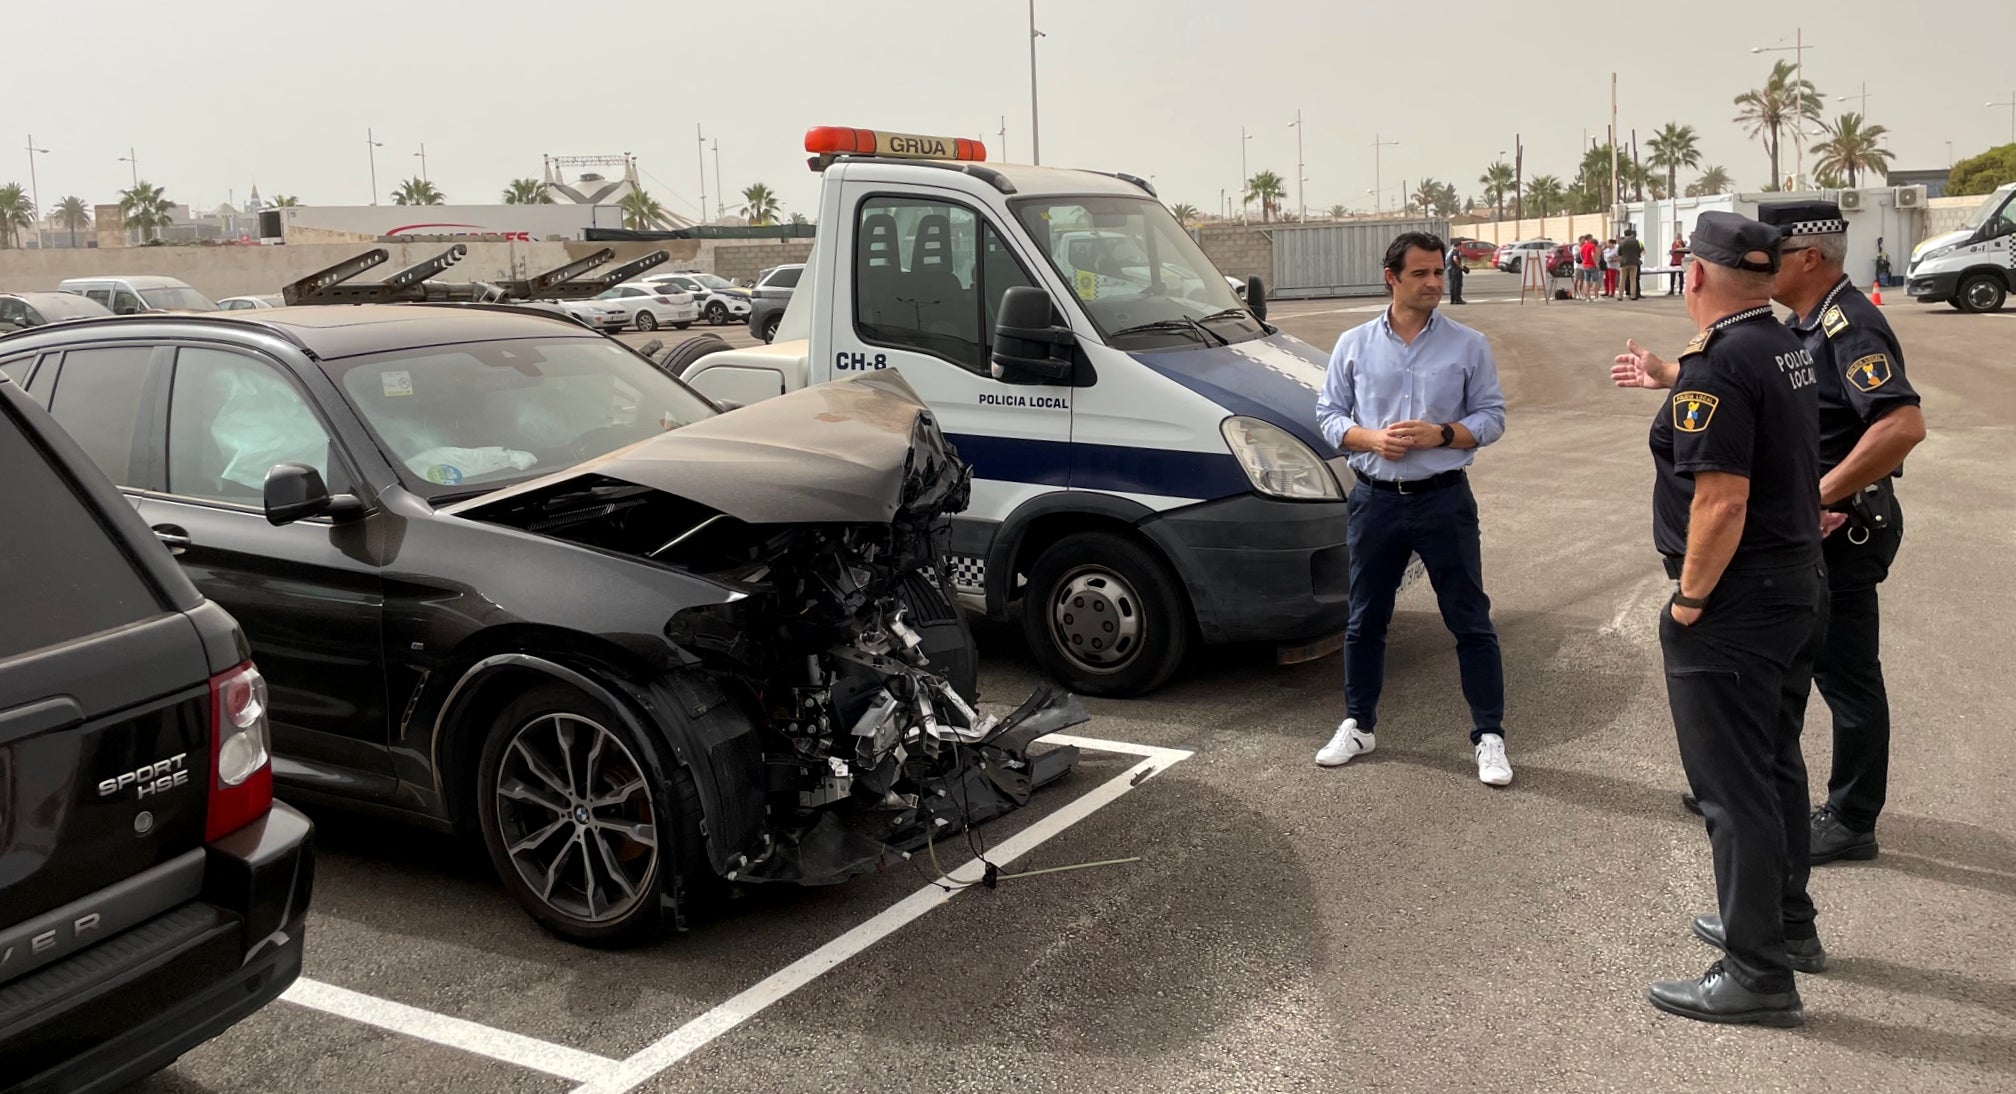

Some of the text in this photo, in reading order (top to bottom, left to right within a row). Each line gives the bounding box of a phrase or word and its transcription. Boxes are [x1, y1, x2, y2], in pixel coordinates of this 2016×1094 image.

[889, 136, 946, 156] GRUA
[836, 352, 887, 371] CH-8
[1789, 367, 1817, 390] LOCAL
[979, 394, 1069, 409] POLICIA LOCAL
[99, 753, 187, 797] SPORT
[137, 769, 189, 800] HSE
